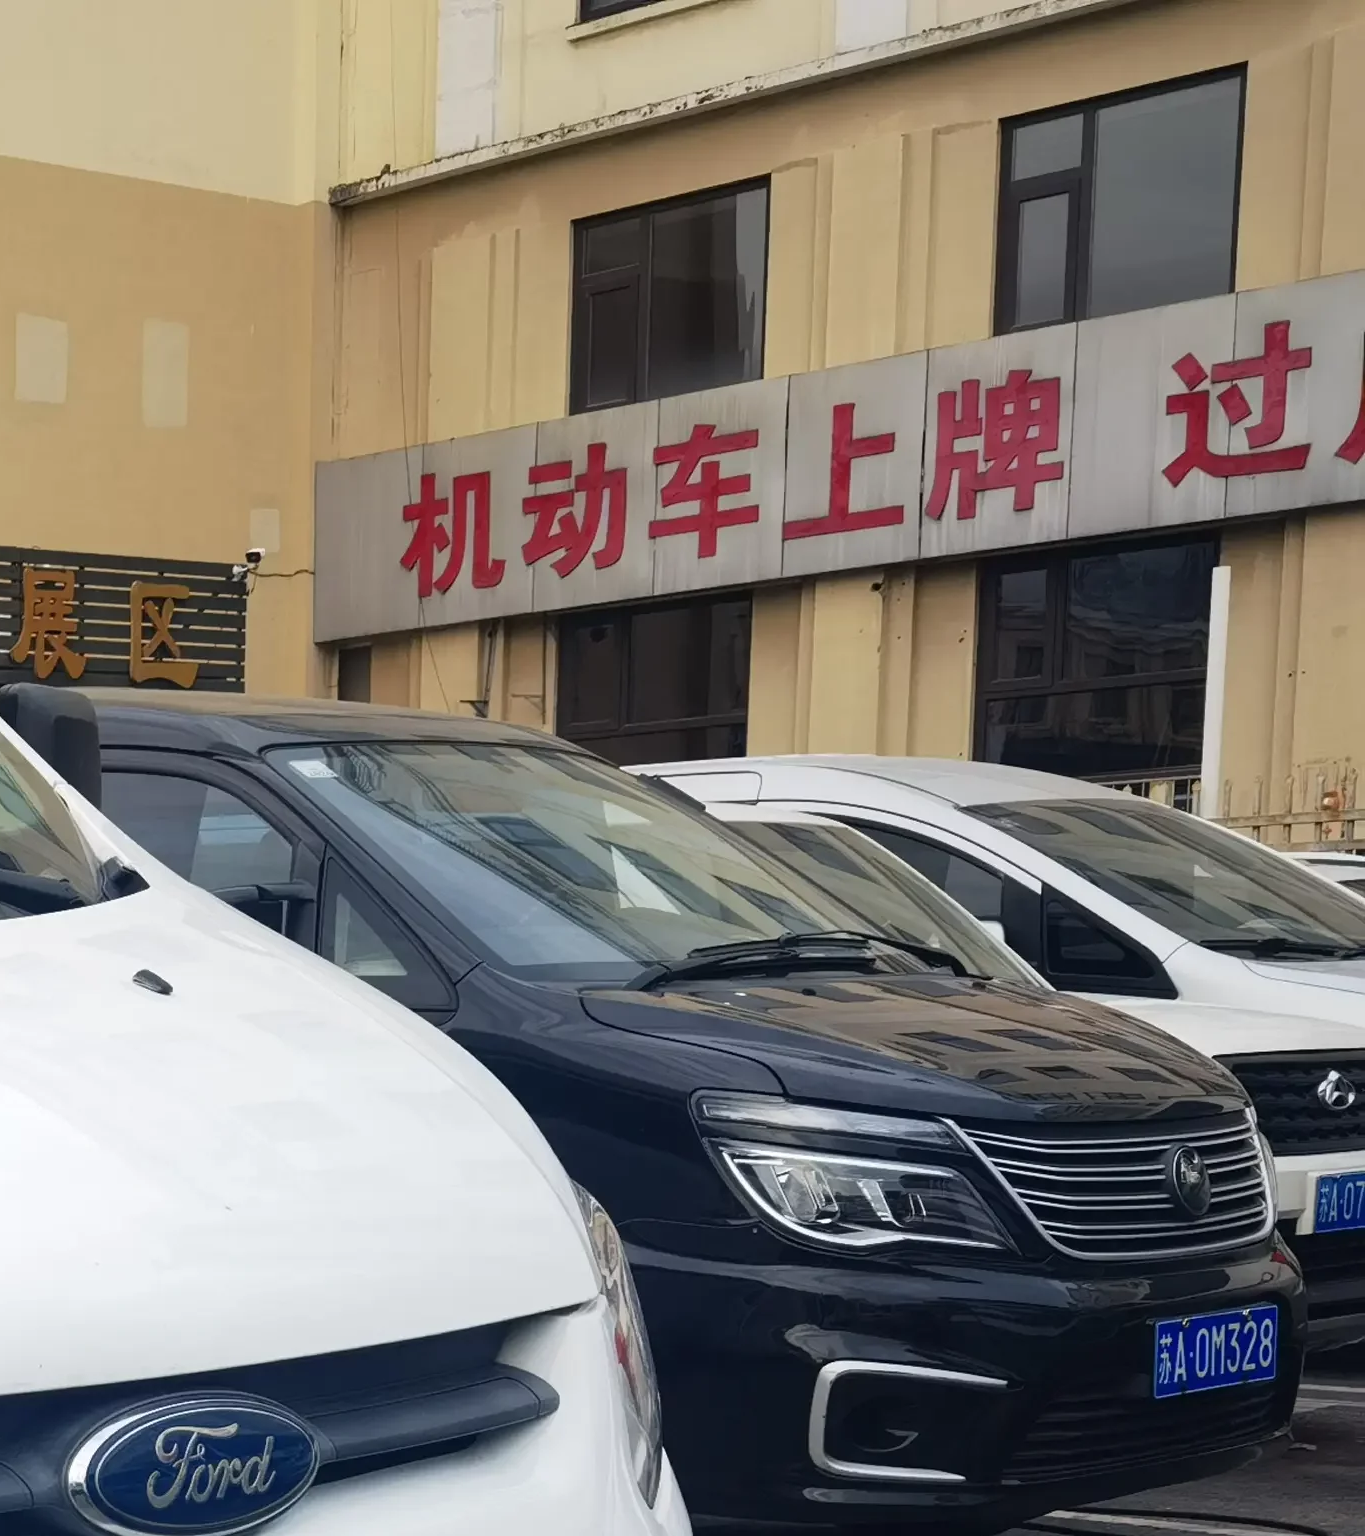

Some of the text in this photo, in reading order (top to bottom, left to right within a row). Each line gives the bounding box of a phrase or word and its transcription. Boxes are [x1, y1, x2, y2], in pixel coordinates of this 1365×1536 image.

[400, 319, 1365, 599] 机动车上牌 过
[145, 1422, 277, 1510] Ford
